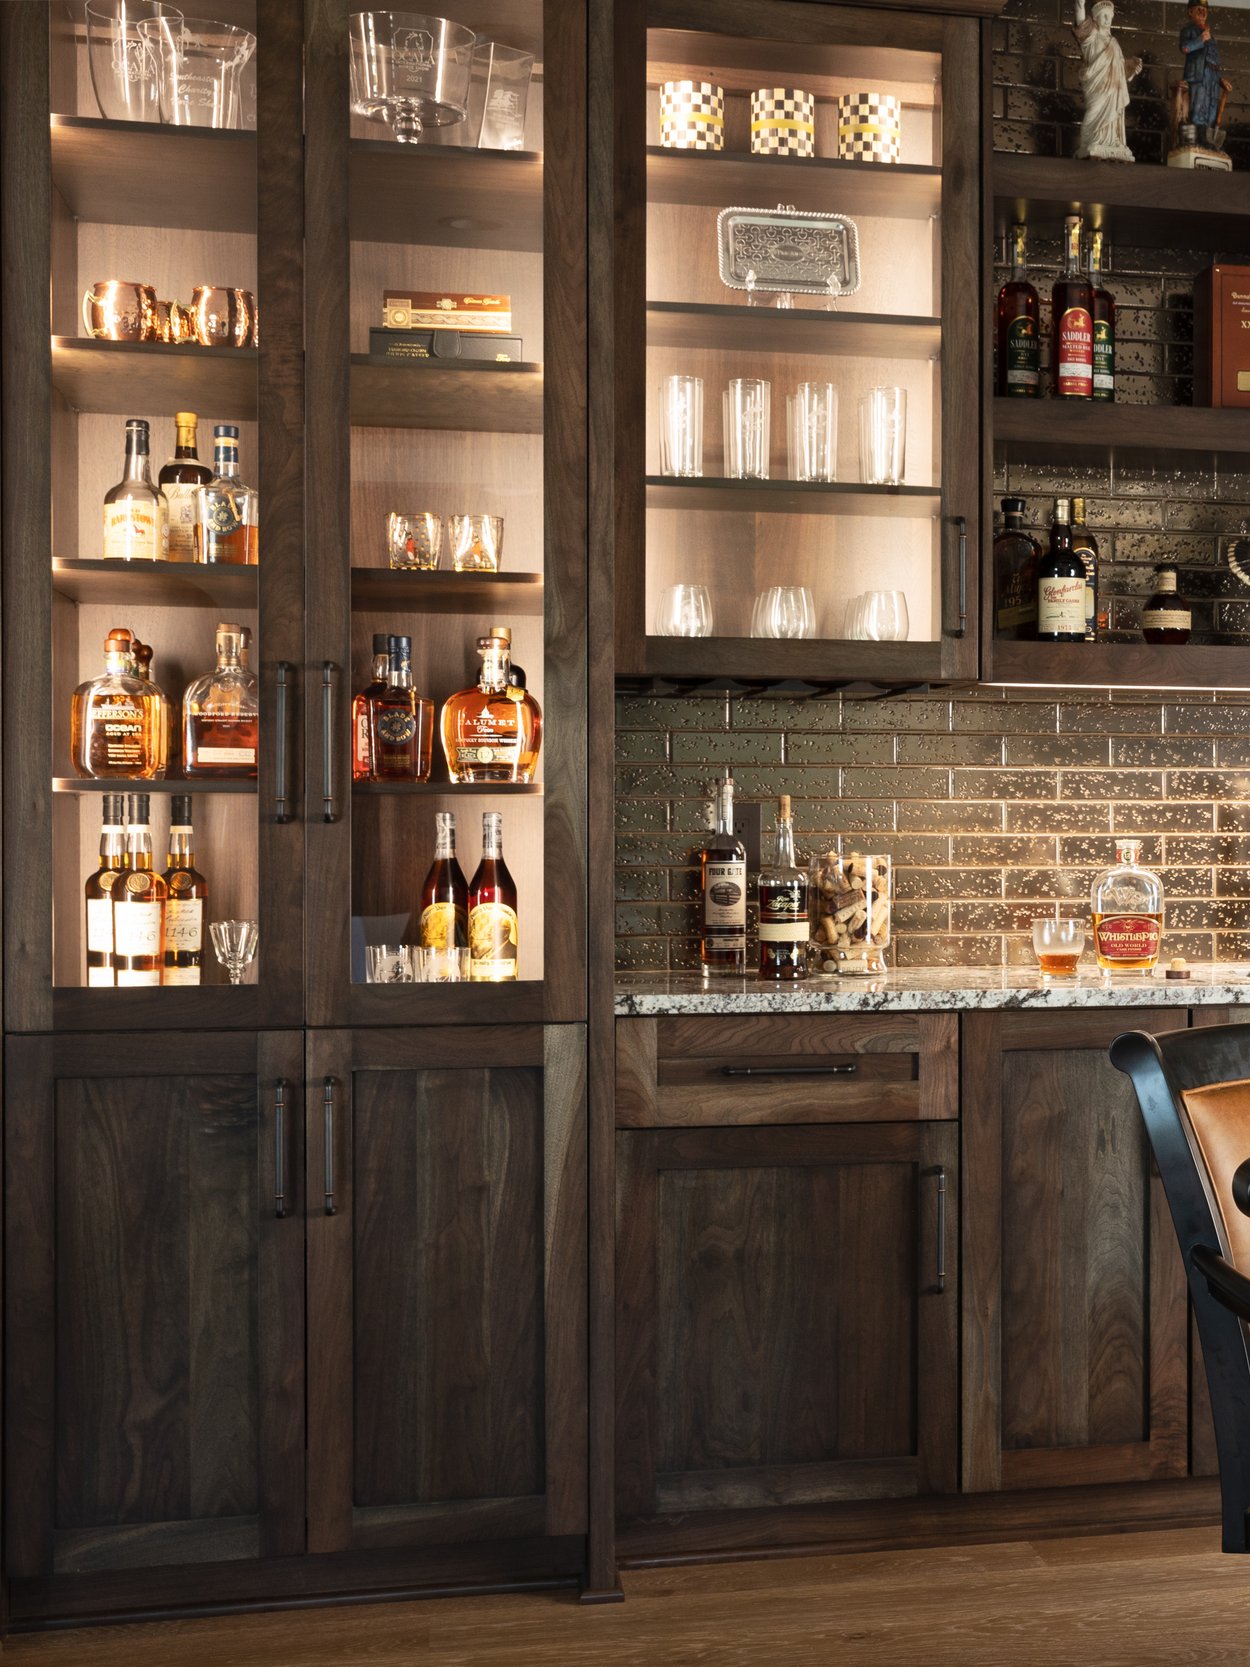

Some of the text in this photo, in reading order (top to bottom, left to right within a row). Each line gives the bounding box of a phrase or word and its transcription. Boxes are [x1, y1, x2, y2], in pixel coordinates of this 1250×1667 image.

[407, 75, 423, 83] 2021
[1062, 331, 1091, 343] SADDLER
[1093, 343, 1112, 354] DDLER
[92, 709, 144, 719] EFFERSON'S
[459, 719, 516, 727] ALUMET
[708, 868, 742, 876] FOUR GTE
[1098, 931, 1158, 943] WHISTLEPIG
